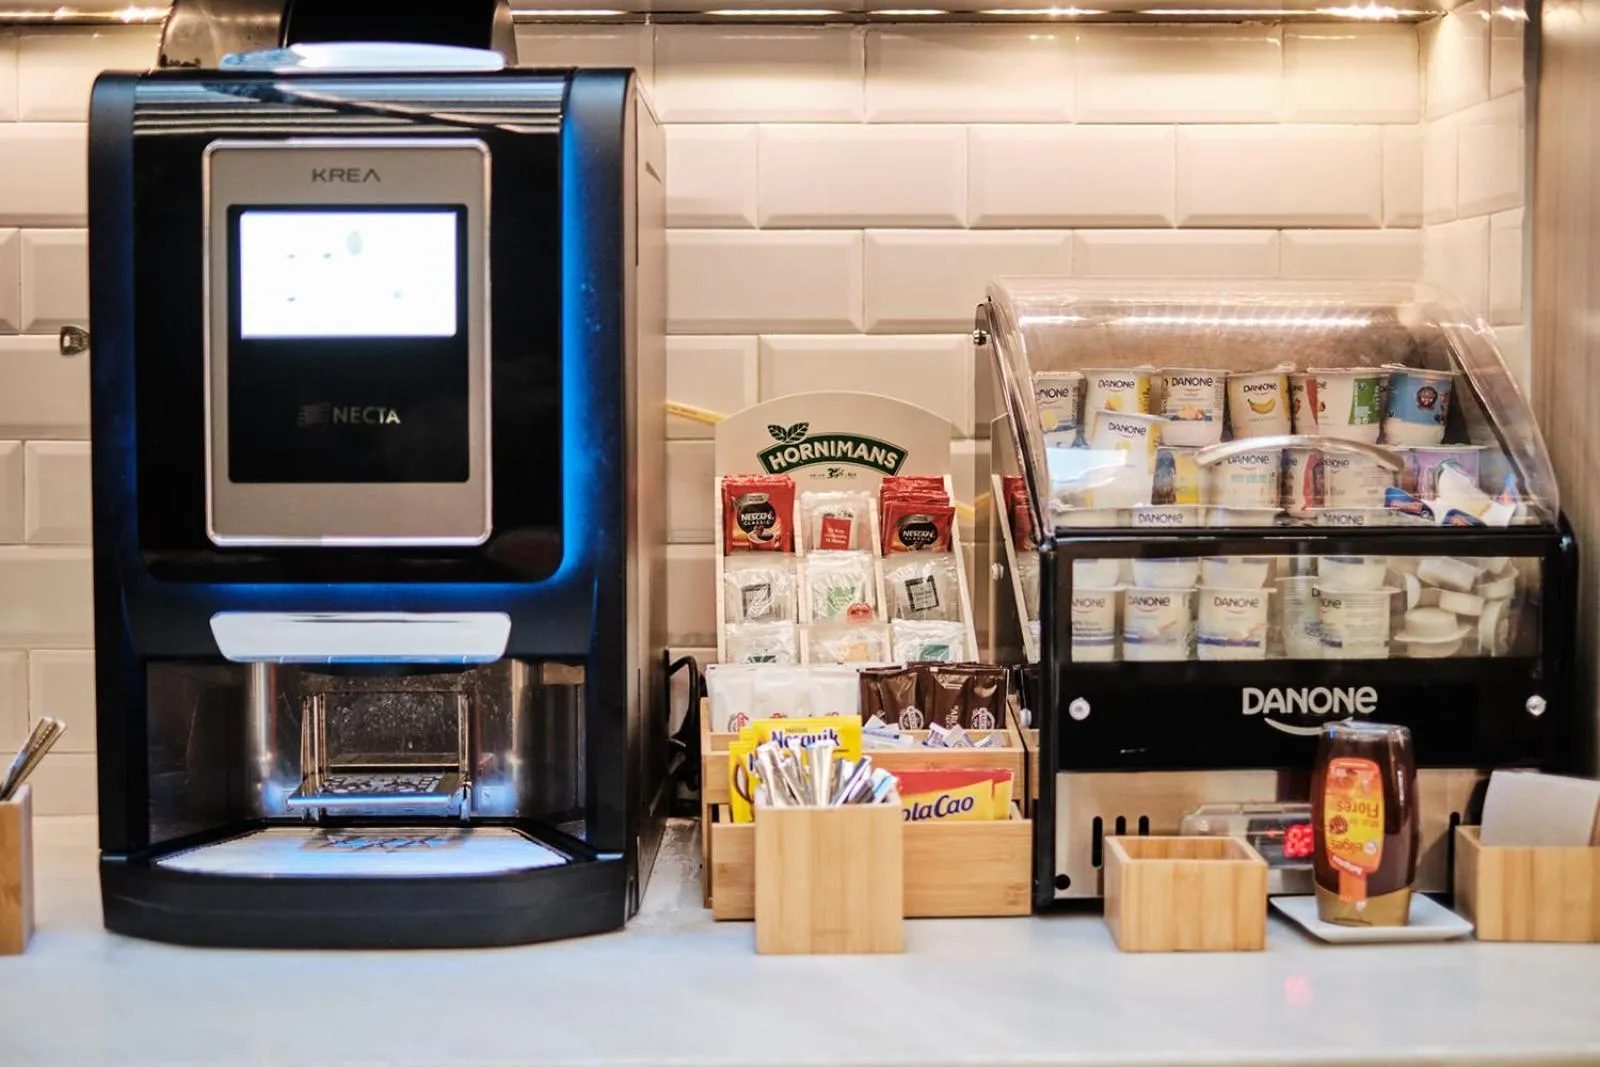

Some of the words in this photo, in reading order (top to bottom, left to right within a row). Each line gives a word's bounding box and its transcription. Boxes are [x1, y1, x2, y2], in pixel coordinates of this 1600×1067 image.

[333, 406, 401, 424] NECTA
[768, 440, 898, 471] HORNIMANS
[1336, 801, 1379, 818] Flores
